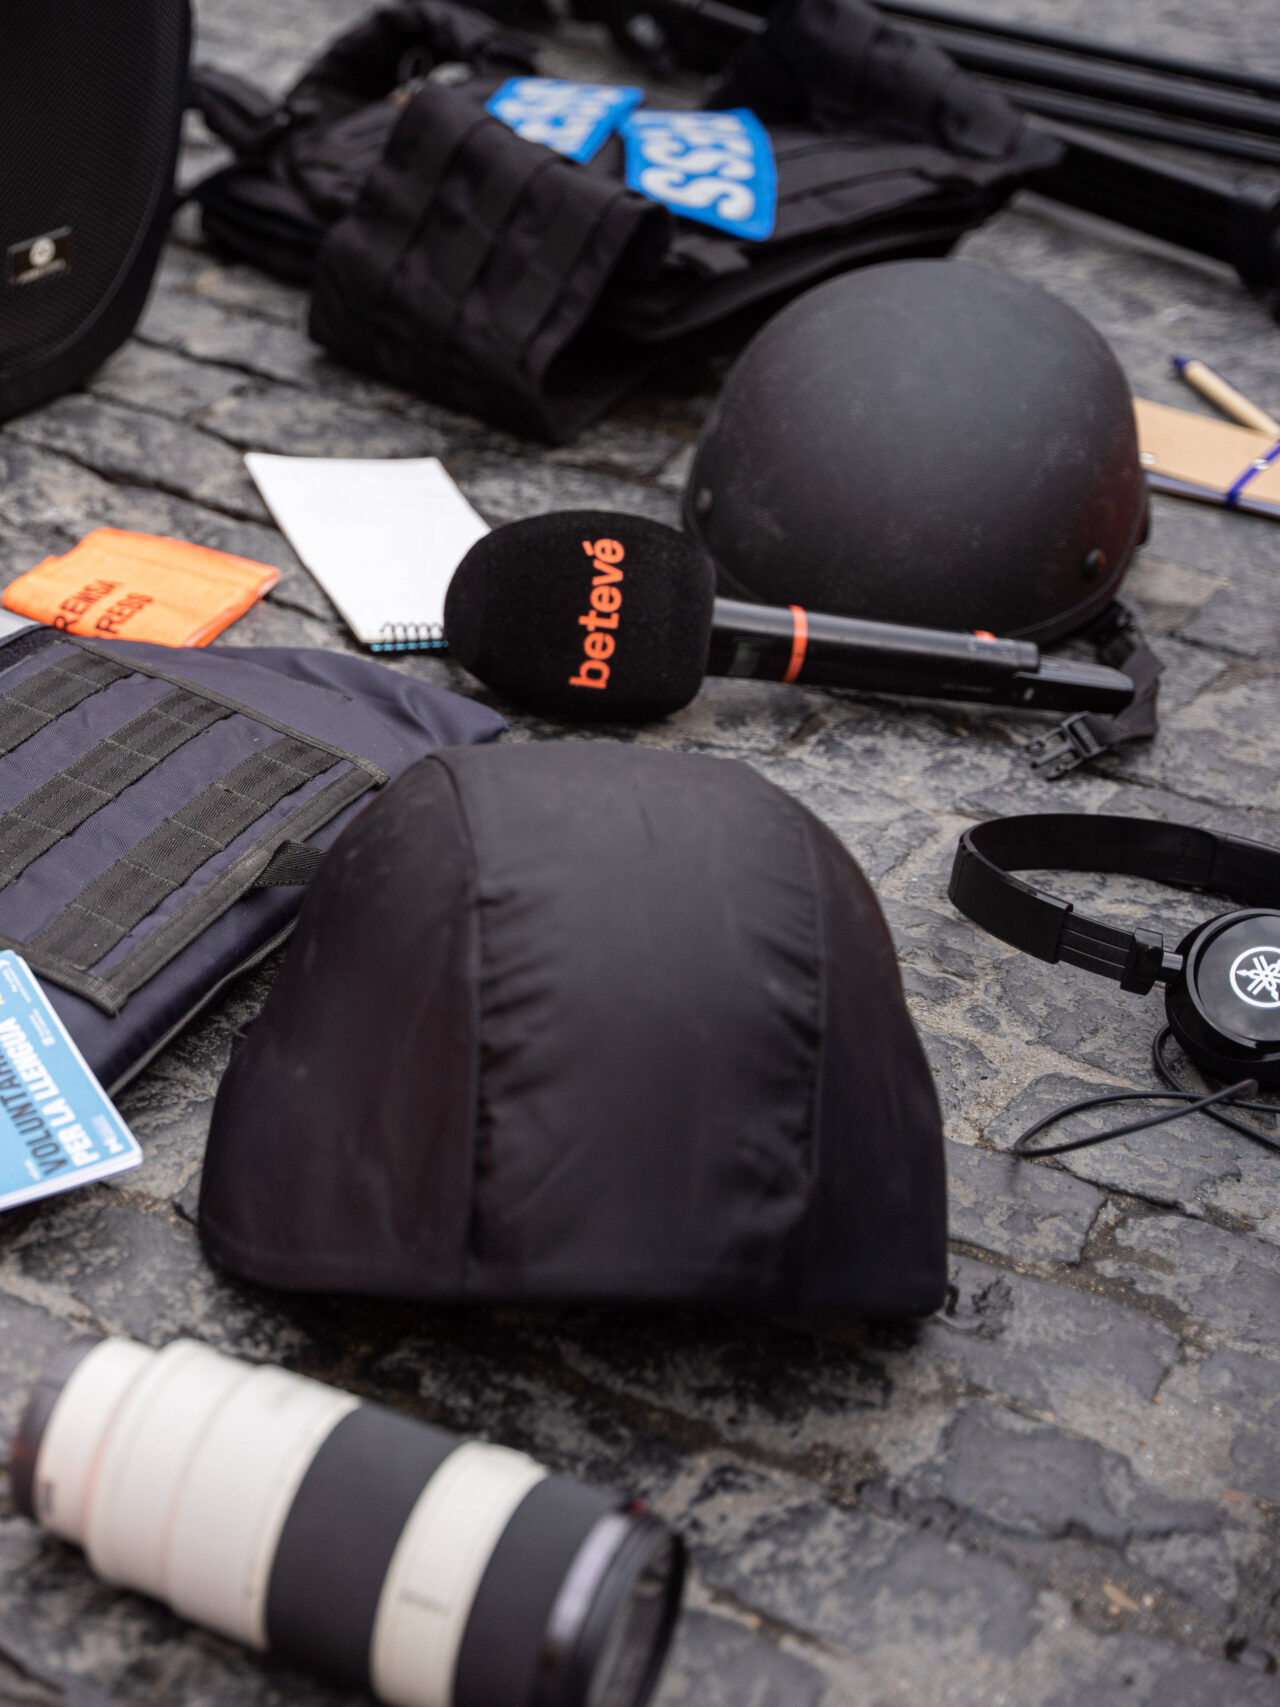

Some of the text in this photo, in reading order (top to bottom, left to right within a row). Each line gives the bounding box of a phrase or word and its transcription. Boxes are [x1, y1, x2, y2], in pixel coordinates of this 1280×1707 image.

[95, 592, 155, 635] RESS
[568, 538, 625, 689] betevé
[42, 1097, 76, 1128] LA
[58, 1123, 100, 1167] PER
